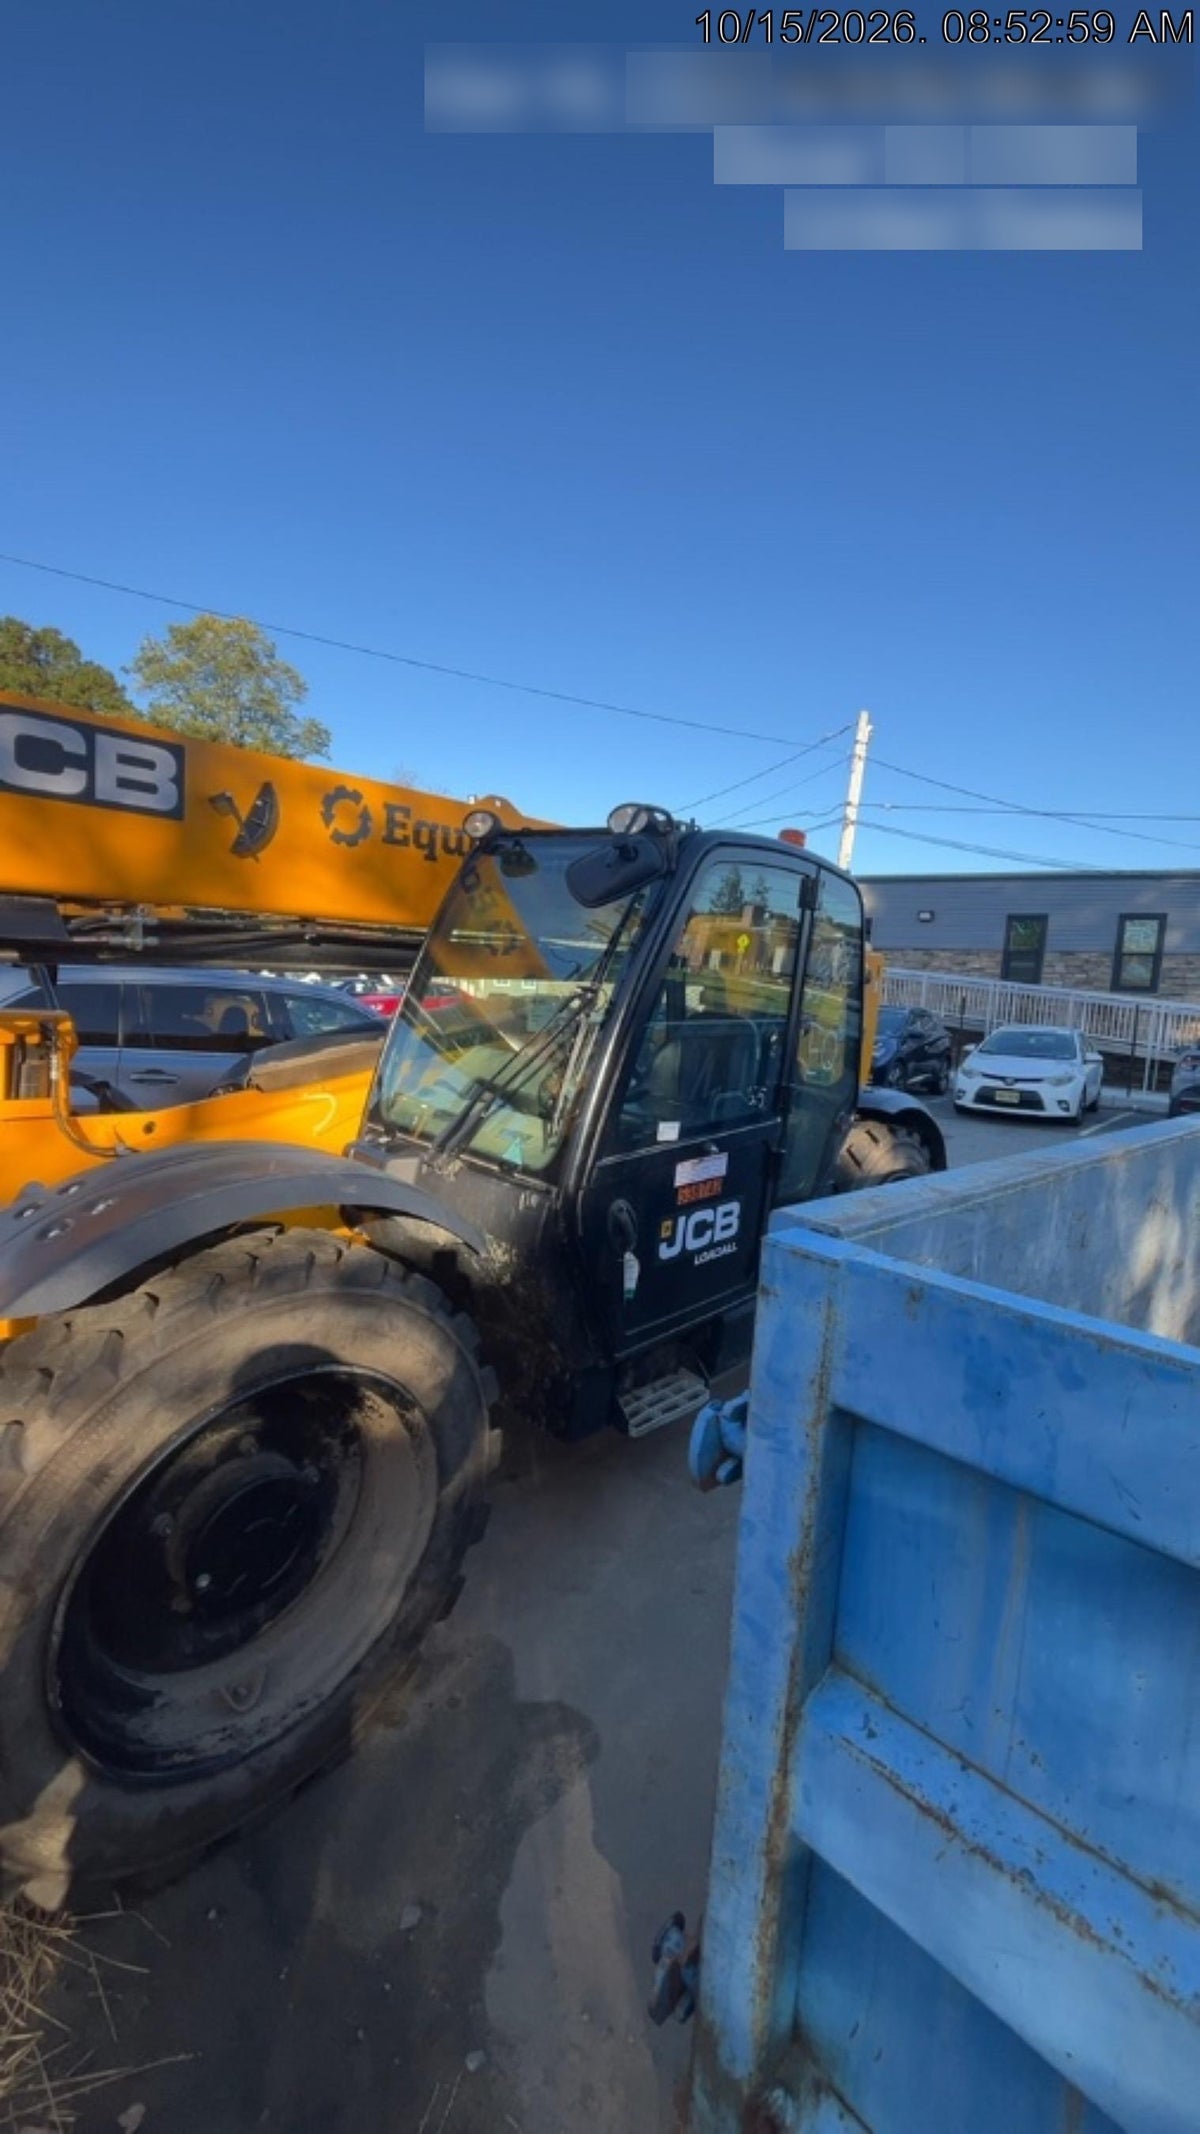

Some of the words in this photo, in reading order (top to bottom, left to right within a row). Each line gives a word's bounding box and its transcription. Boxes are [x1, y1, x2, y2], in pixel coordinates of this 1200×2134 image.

[0, 713, 179, 812] CB
[658, 1201, 741, 1260] JCB
[694, 1242, 738, 1265] LOADALL
